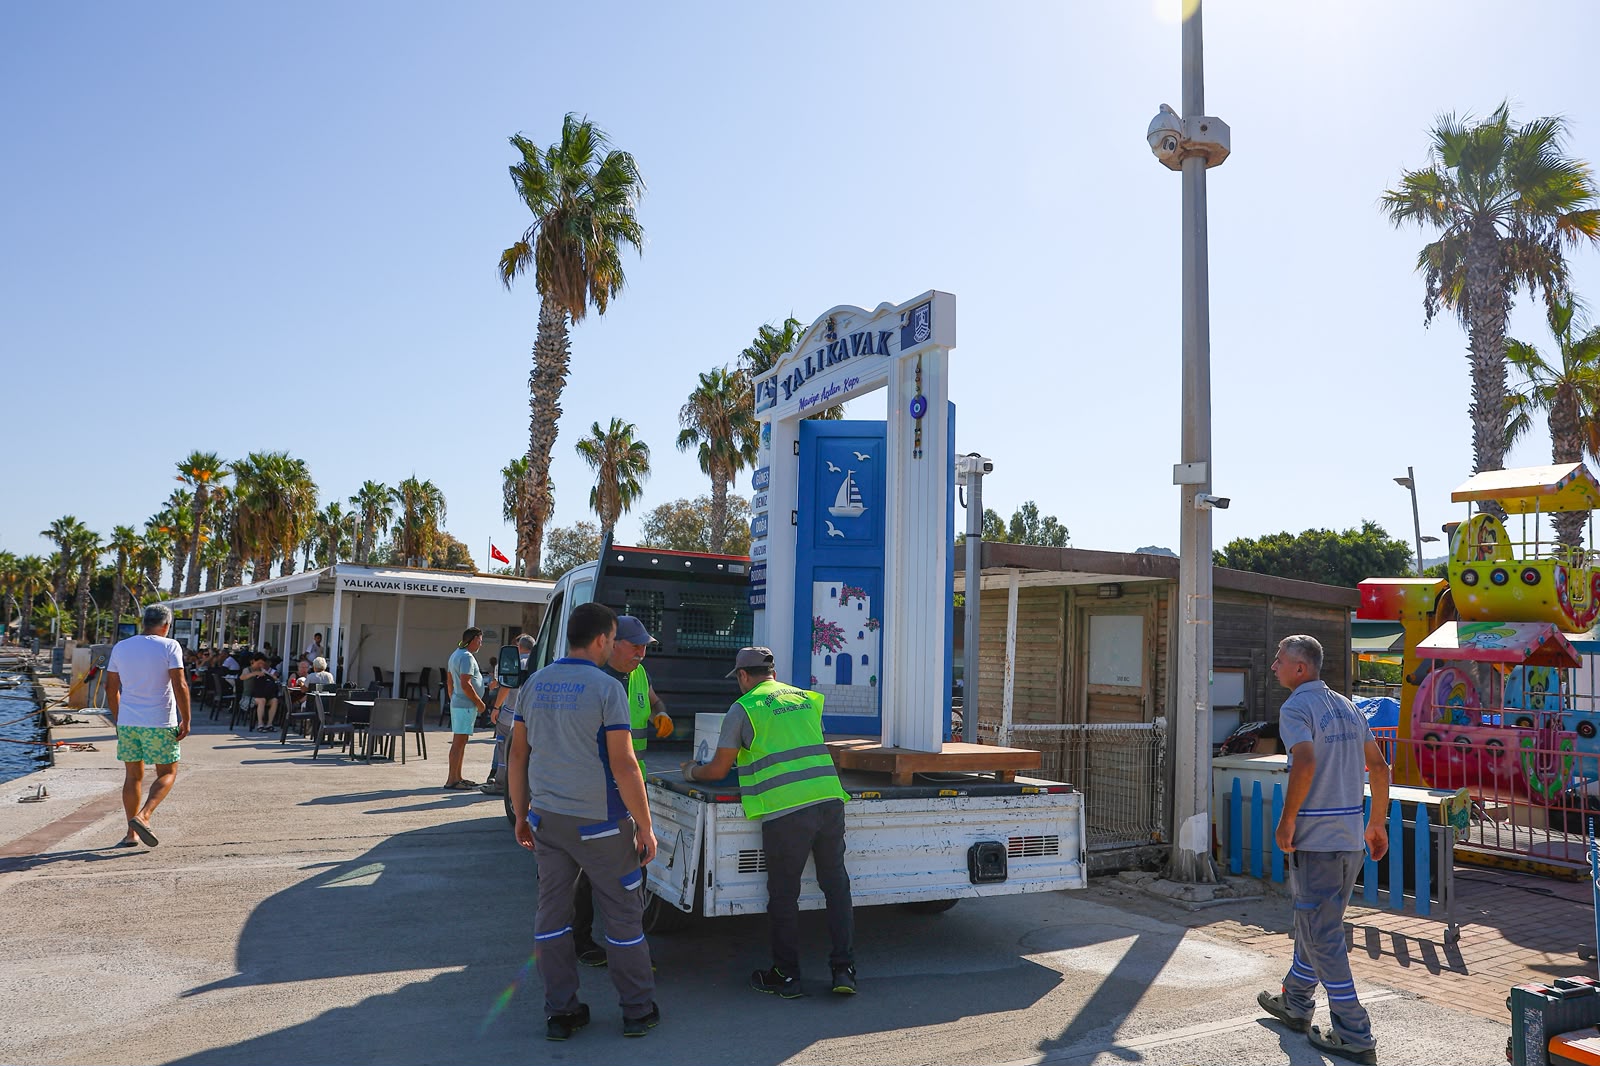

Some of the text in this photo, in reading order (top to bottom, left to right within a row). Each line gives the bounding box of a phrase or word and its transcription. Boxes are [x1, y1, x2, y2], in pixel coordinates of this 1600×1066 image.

[781, 331, 893, 400] YALIKAVAK
[343, 579, 466, 594] YALIKAVAK İSKELE CAFE
[535, 682, 586, 694] BODRUM
